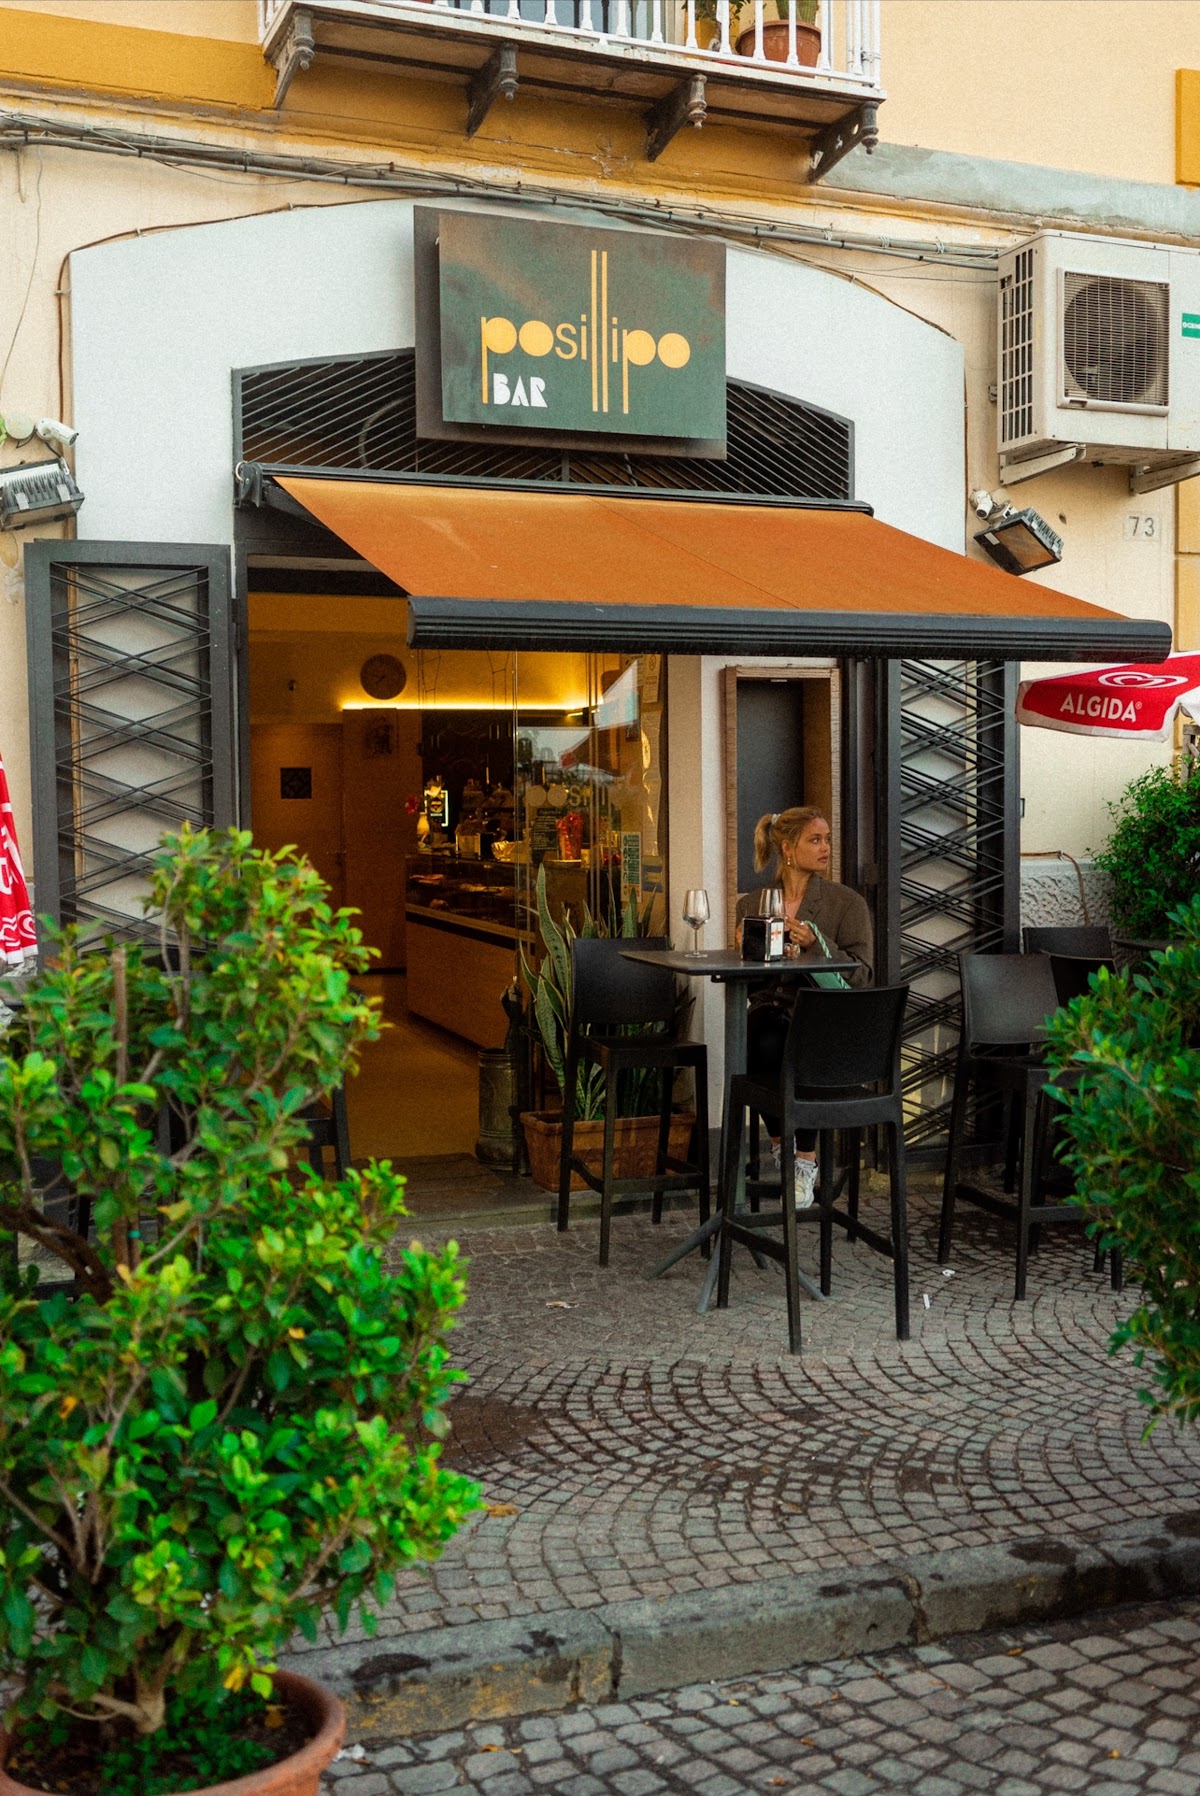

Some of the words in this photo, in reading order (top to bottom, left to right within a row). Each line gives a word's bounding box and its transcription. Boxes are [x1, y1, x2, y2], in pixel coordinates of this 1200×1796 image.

[481, 250, 691, 414] posillipo
[493, 373, 548, 408] BAR
[1129, 515, 1155, 537] 73
